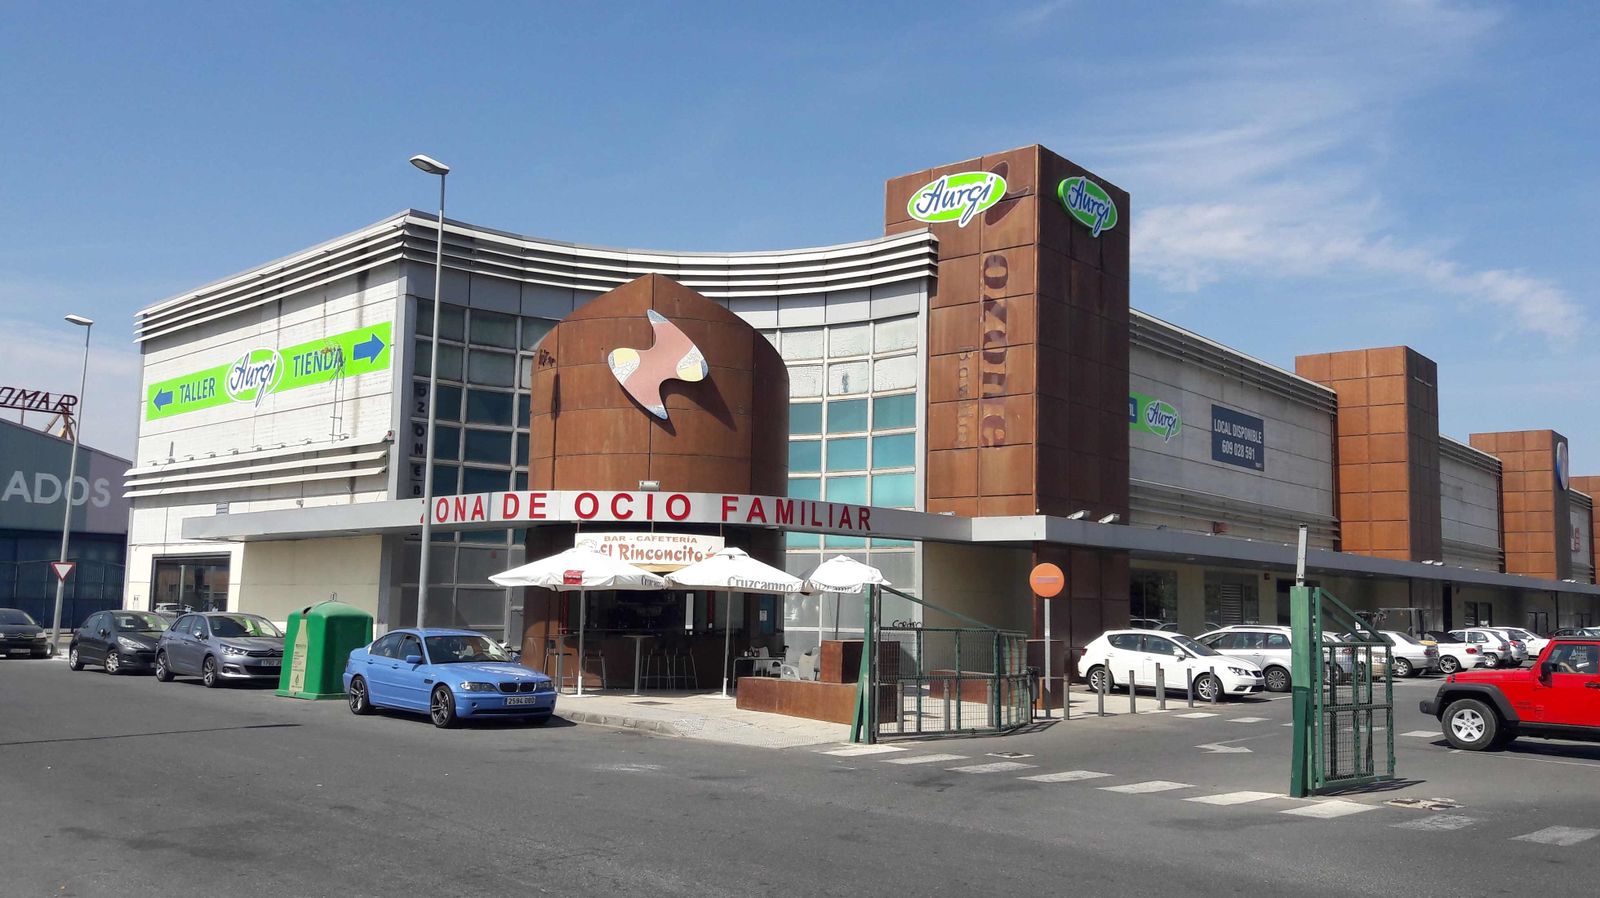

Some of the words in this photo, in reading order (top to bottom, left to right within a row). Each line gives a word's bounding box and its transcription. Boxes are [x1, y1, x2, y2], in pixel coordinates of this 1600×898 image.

[916, 176, 994, 225] Aurgi
[1068, 180, 1110, 233] Aurgi
[293, 345, 344, 378] TIENDA
[179, 377, 216, 404] TALLER
[230, 351, 277, 408] Aurgi
[1147, 402, 1178, 442] Aurgi
[1214, 418, 1231, 436] LOCAL
[1233, 423, 1262, 444] DISPONIBLE
[1221, 439, 1233, 455] 609
[1234, 442, 1245, 458] 028
[1245, 445, 1255, 460] 591
[2, 470, 111, 508] ADOS
[502, 493, 547, 519] DE
[574, 492, 691, 521] OCIO
[721, 495, 871, 531] FAMILIAR
[618, 543, 703, 562] Rinconcito
[636, 535, 698, 544] CAFETERÍA
